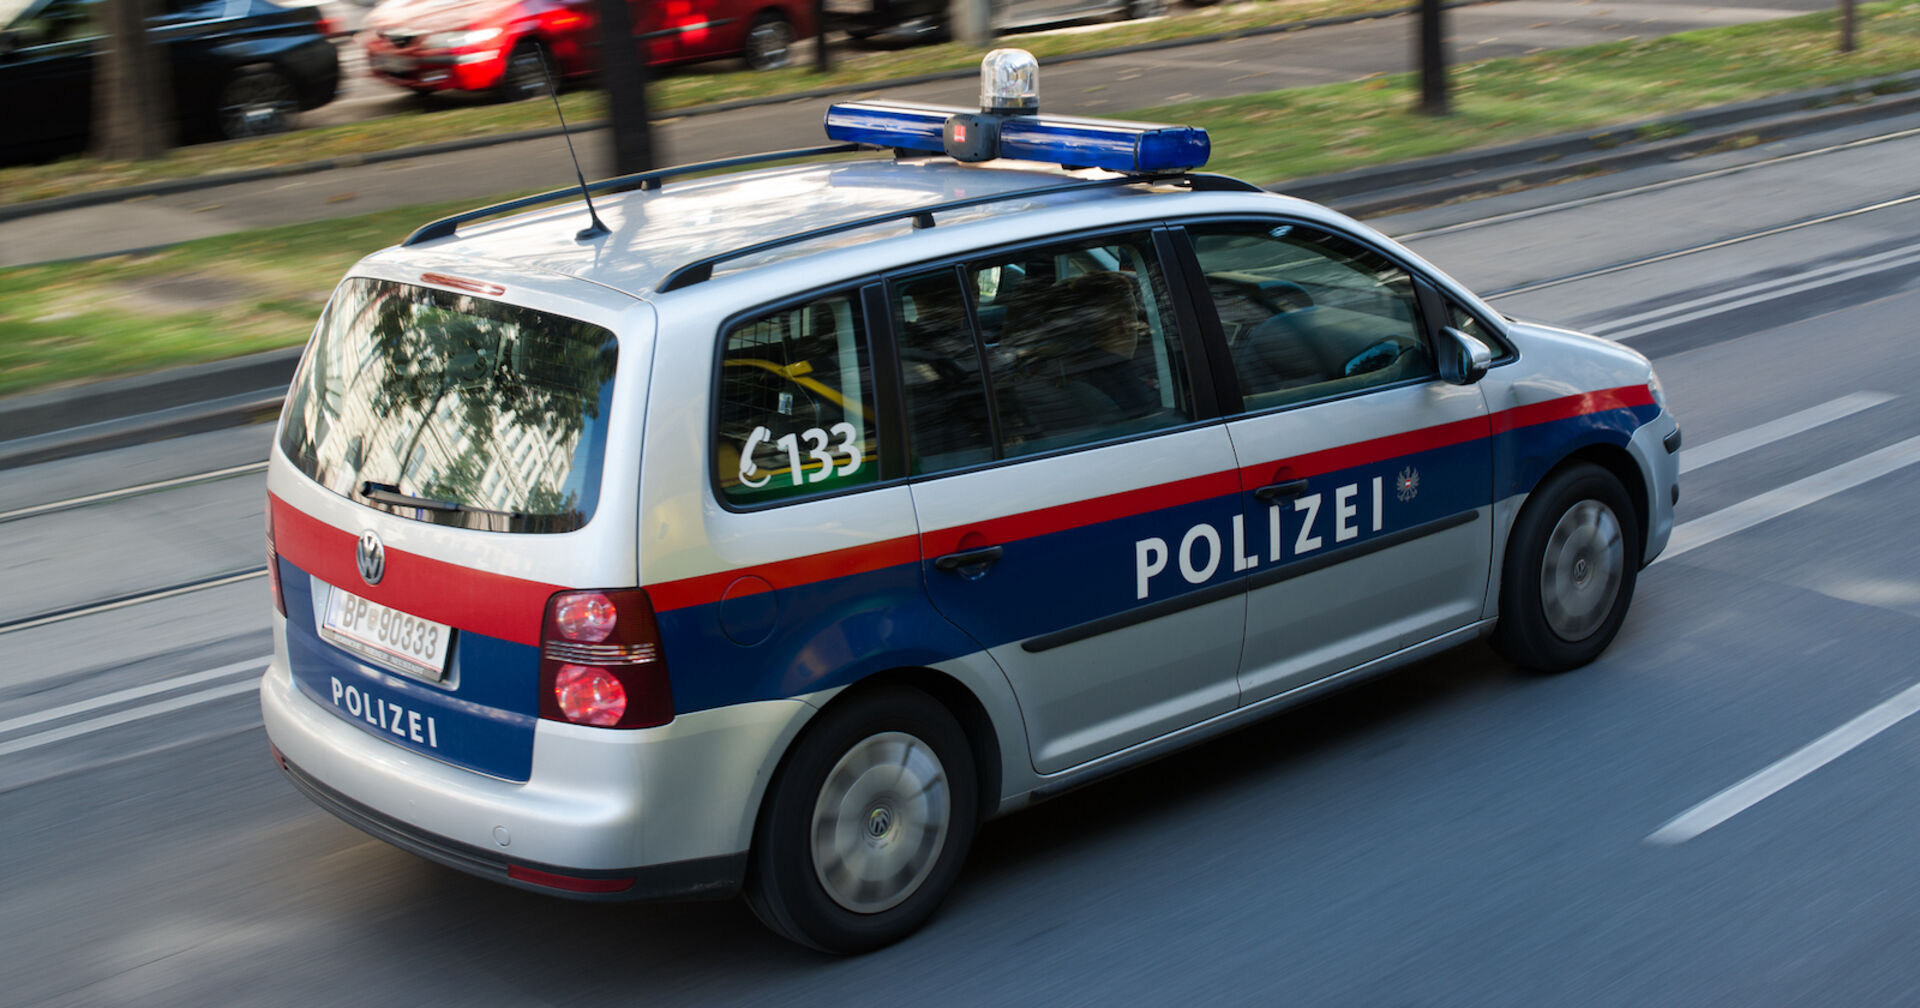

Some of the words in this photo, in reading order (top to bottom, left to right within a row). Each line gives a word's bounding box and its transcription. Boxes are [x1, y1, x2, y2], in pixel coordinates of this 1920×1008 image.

[777, 422, 862, 486] 133
[1136, 476, 1383, 600] POLIZEI
[342, 593, 368, 631] BP
[378, 607, 439, 660] 90333
[331, 676, 437, 748] POLIZEI
